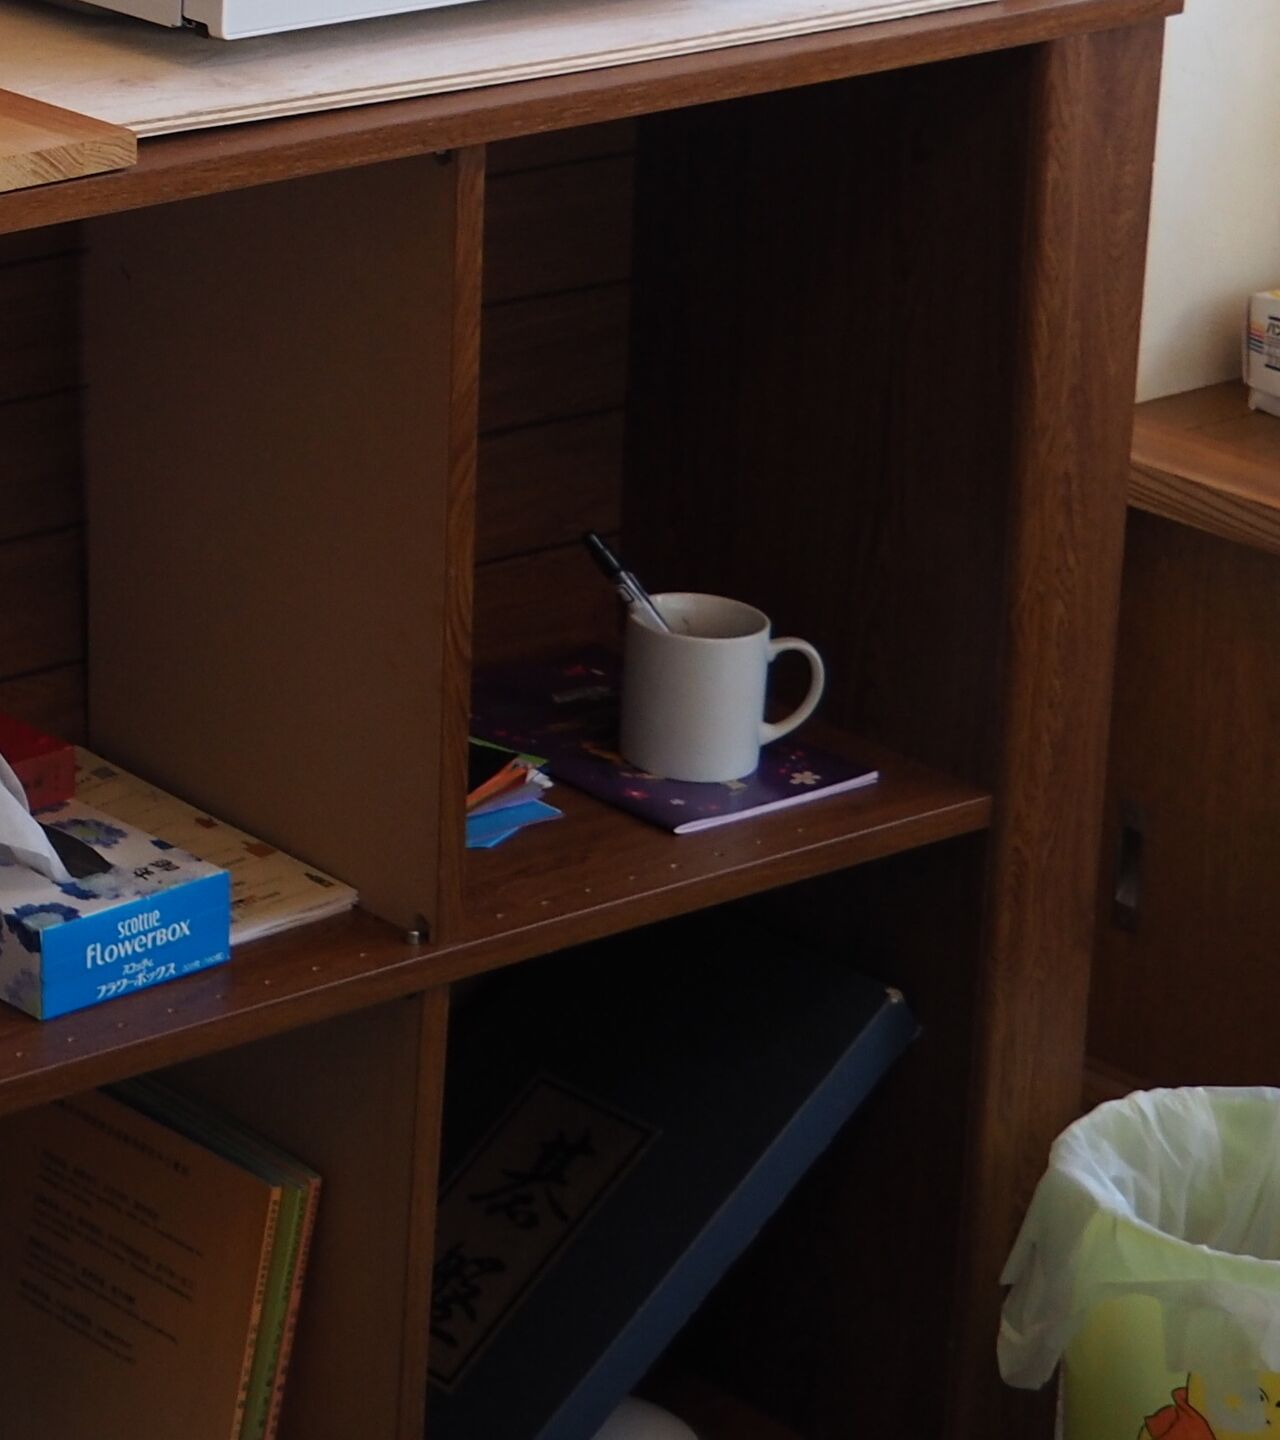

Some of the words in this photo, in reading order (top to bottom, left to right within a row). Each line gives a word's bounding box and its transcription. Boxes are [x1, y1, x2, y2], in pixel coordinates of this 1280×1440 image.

[117, 909, 161, 940] scottie
[96, 962, 177, 1000] フラワーボックス
